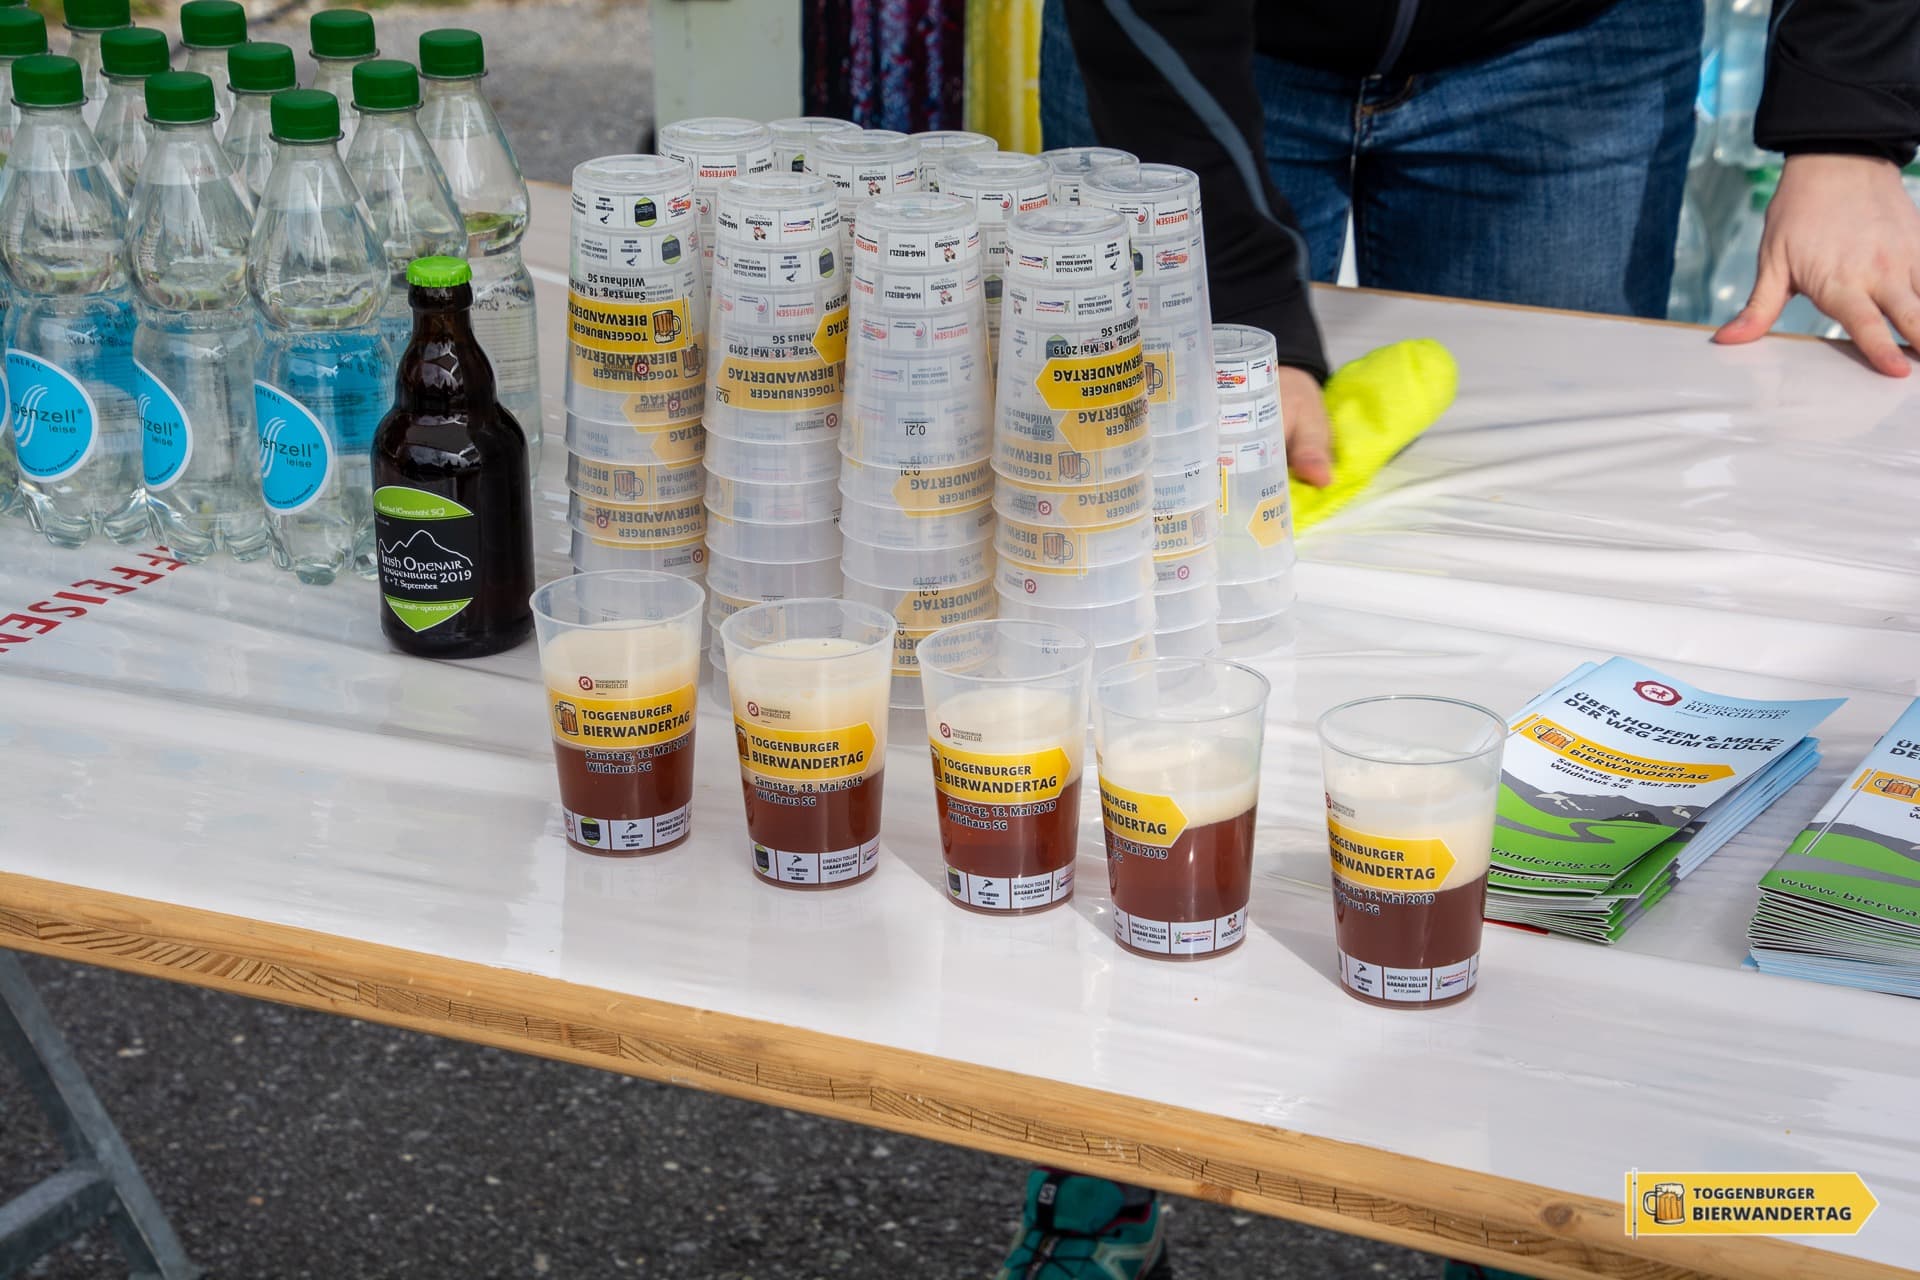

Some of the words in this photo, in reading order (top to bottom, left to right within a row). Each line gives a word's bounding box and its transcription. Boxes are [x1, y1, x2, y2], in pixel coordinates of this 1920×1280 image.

[700, 169, 737, 178] RAIFFEISEN
[745, 216, 773, 227] stockberg
[1156, 212, 1188, 226] RAIFFEISEN
[889, 249, 926, 258] HAG-BEIZLI
[587, 273, 599, 285] SG
[599, 275, 646, 287] Wildhaus
[586, 285, 599, 297] 18.
[600, 287, 647, 300] Samstag,
[885, 290, 921, 300] HAG-BEIZLI
[776, 306, 815, 318] RAIFFEISEN
[573, 321, 648, 342] TOGGENBURGER
[1101, 327, 1113, 338] SG
[772, 335, 786, 345] SG
[1101, 342, 1115, 352] 18.
[575, 345, 678, 365] BIERWANDERTAG
[729, 344, 749, 356] 2019
[751, 348, 769, 359] Mai
[771, 349, 786, 358] 18.
[1053, 346, 1078, 356] 2019
[1080, 344, 1099, 356] Mai
[593, 367, 679, 381] TOGGENBURGER
[728, 366, 834, 385] BIERWANDERTAG
[750, 383, 835, 400] TOGGENBURGER
[49, 424, 77, 434] leise
[151, 434, 173, 446] leise
[286, 458, 312, 468] leise
[1261, 485, 1277, 497] 2019
[596, 504, 700, 523] BIERWANDERTAG
[618, 520, 703, 537] TOGGENBURGER
[439, 569, 472, 583] 2019
[400, 579, 439, 591] September
[581, 703, 673, 721] TOGGENBURGER
[1573, 690, 1621, 720] ÜBER
[1623, 716, 1701, 741] HOPFEN
[1702, 733, 1718, 742] &
[1722, 735, 1784, 746] MALZ:
[1684, 703, 1785, 720] BIERGILDE
[583, 710, 690, 738] BIERWANDERTAG
[1563, 698, 1602, 720] DER
[1605, 718, 1651, 739] WEG
[1653, 734, 1703, 749] ZUM
[750, 735, 840, 753] TOGGENBURGER
[585, 748, 635, 762] Samstag,
[637, 748, 652, 760] 18.
[654, 746, 672, 757] Mai
[752, 751, 864, 770] BIERWANDERTAG
[1579, 743, 1686, 773] TOGGENBURGER
[586, 762, 637, 774] Wildhaus
[638, 761, 652, 773] SG
[943, 756, 1032, 776] TOGGENBURGER
[1569, 749, 1710, 780] BIERWANDERTAG
[1550, 762, 1608, 788] Wildhaus
[1556, 757, 1611, 781] Samstag,
[1618, 778, 1635, 787] 18.
[1638, 780, 1664, 789] Mai
[1666, 782, 1697, 790] 2019
[754, 776, 798, 795] Samstag,
[801, 783, 816, 793] 18.
[819, 781, 839, 792] Mai
[841, 776, 864, 790] 2019
[944, 773, 1057, 794] BIERWANDERTAG
[755, 789, 800, 806] Wildhaus
[801, 797, 816, 807] SG
[948, 798, 990, 817] Samstag,
[992, 805, 1008, 817] 18.
[1010, 804, 1032, 817] Mai
[1033, 801, 1057, 815] 2019
[948, 812, 991, 830] Wildhaus
[993, 819, 1008, 830] SG
[1123, 841, 1140, 855] Mai
[1142, 847, 1168, 860] 2019
[1033, 886, 1050, 894] KOLLER
[1034, 879, 1050, 887] TOLLER
[1364, 891, 1380, 902] 18.
[1382, 893, 1405, 904] Mai
[1407, 893, 1435, 905] 2019
[1780, 876, 1920, 918] www.bierwa
[1366, 904, 1380, 915] SG
[1386, 974, 1408, 982] EINFACH
